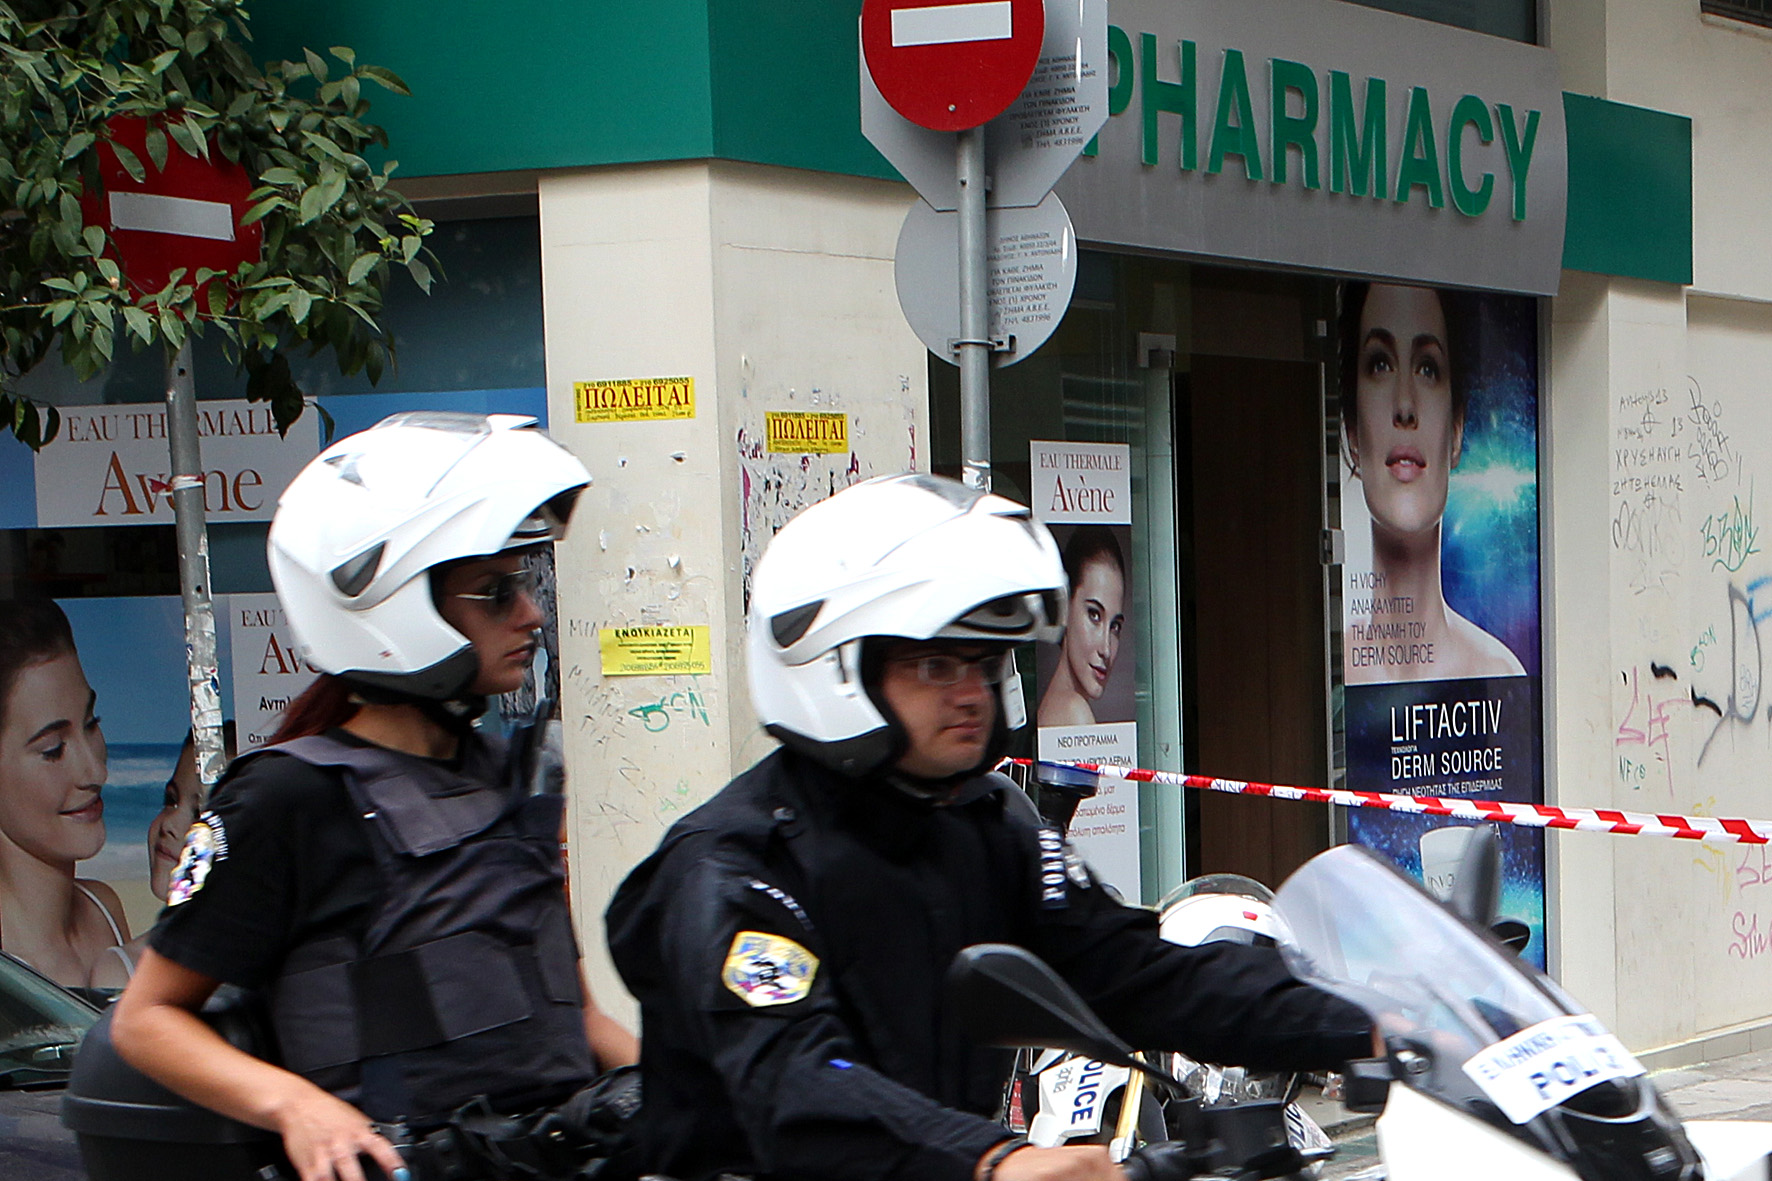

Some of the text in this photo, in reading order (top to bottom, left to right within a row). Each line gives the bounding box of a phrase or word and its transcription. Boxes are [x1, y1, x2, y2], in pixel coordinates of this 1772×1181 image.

[1081, 23, 1542, 222] PHARMACY
[584, 384, 691, 409] ΠΩΛΕΙΤΑΙ
[68, 408, 280, 442] EAU THMALE
[772, 418, 845, 440] ΠΩΛΕΙΤΑΙ
[1040, 453, 1123, 471] EAU THERMALE
[92, 450, 264, 516] Avne
[1051, 473, 1115, 513] Avène
[1360, 571, 1387, 589] VICHY
[1350, 597, 1414, 615] ΑΝΑΚΑΛΥΠΤΕΙ
[241, 610, 276, 627] EAU
[1351, 622, 1427, 641] ΤΗ ΔΥΝΑΜΗ ΤΟΥ
[1352, 643, 1435, 667] DERM SOURCE
[1391, 699, 1502, 742] LIFTACTIV
[1057, 734, 1119, 748] ΝΕΟ ΠΡΟΓΡΑΜΜΑ
[1391, 747, 1503, 780] DERM SOURCE
[1070, 1059, 1105, 1125] OLICE
